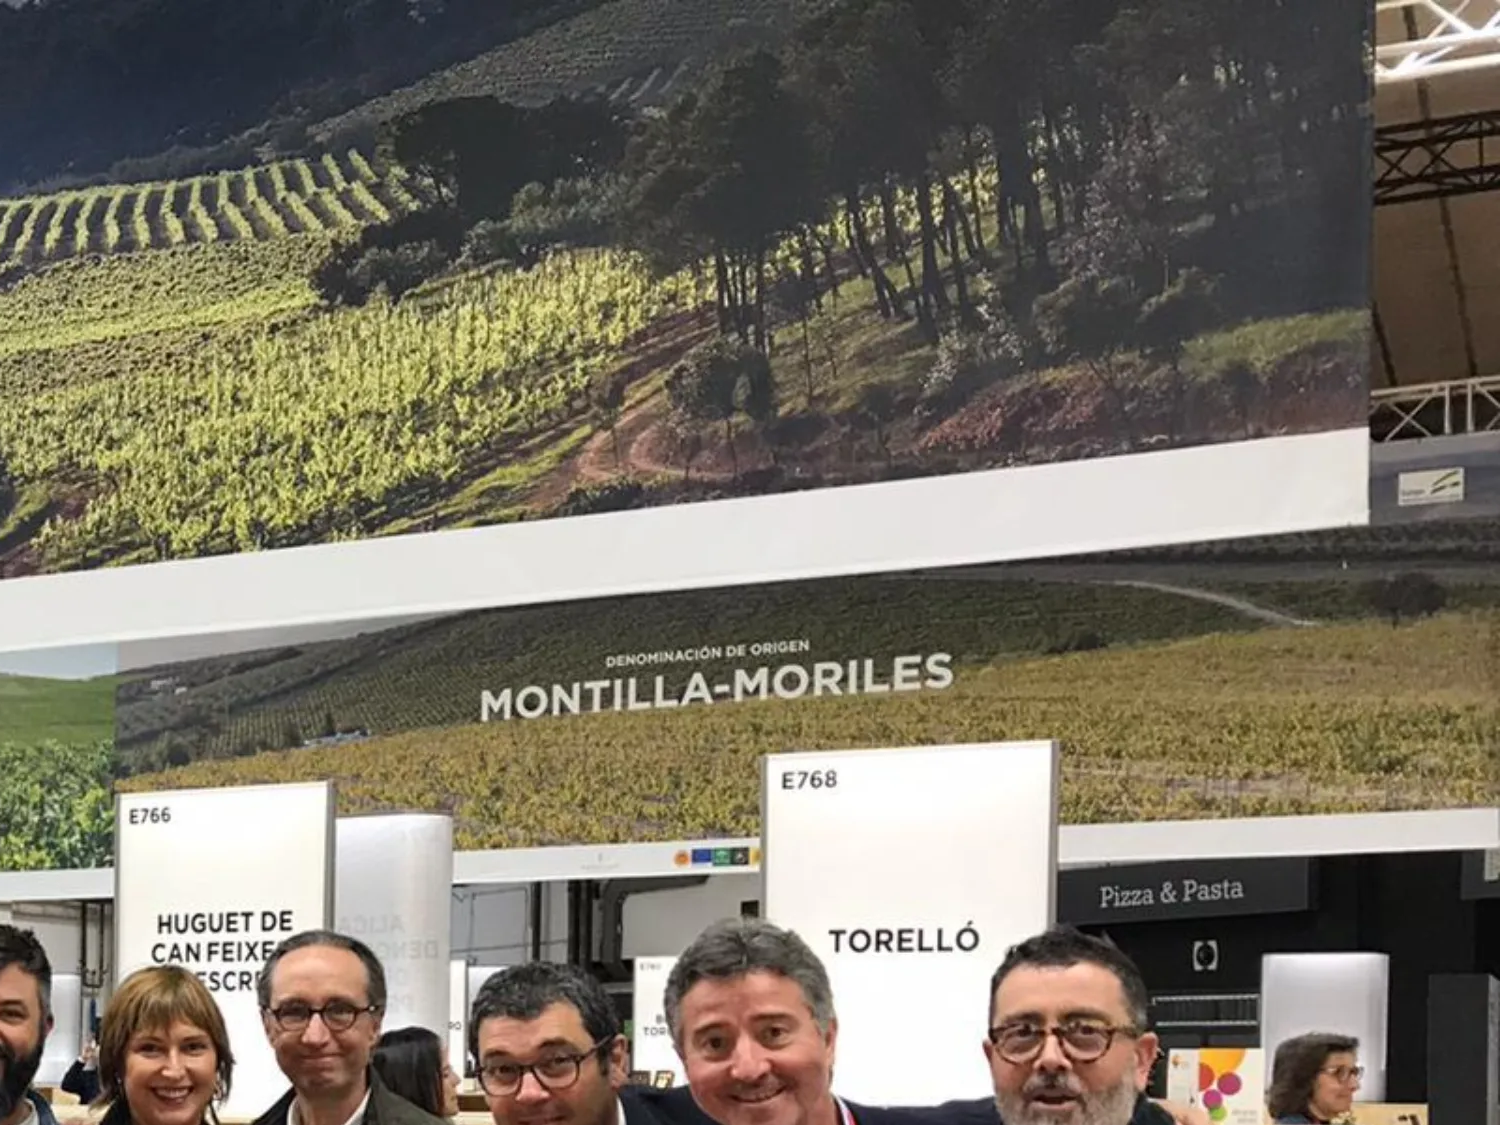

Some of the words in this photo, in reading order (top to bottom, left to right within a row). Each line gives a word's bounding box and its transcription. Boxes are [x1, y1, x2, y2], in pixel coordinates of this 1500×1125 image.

[606, 645, 722, 668] DENOMINACIÓN
[725, 643, 746, 657] DE
[749, 639, 810, 656] ORIGEN
[480, 651, 955, 723] MONTILLA-MORILES
[781, 769, 838, 790] E768
[129, 807, 172, 824] E766
[1100, 885, 1155, 908] Pizza
[1160, 881, 1178, 904] &
[1182, 878, 1245, 903] Pasta
[157, 911, 255, 934] HUGUET
[261, 910, 294, 932] DE
[828, 920, 980, 953] TORELLÓ
[151, 943, 201, 963] CAN
[207, 941, 277, 963] FEIXE
